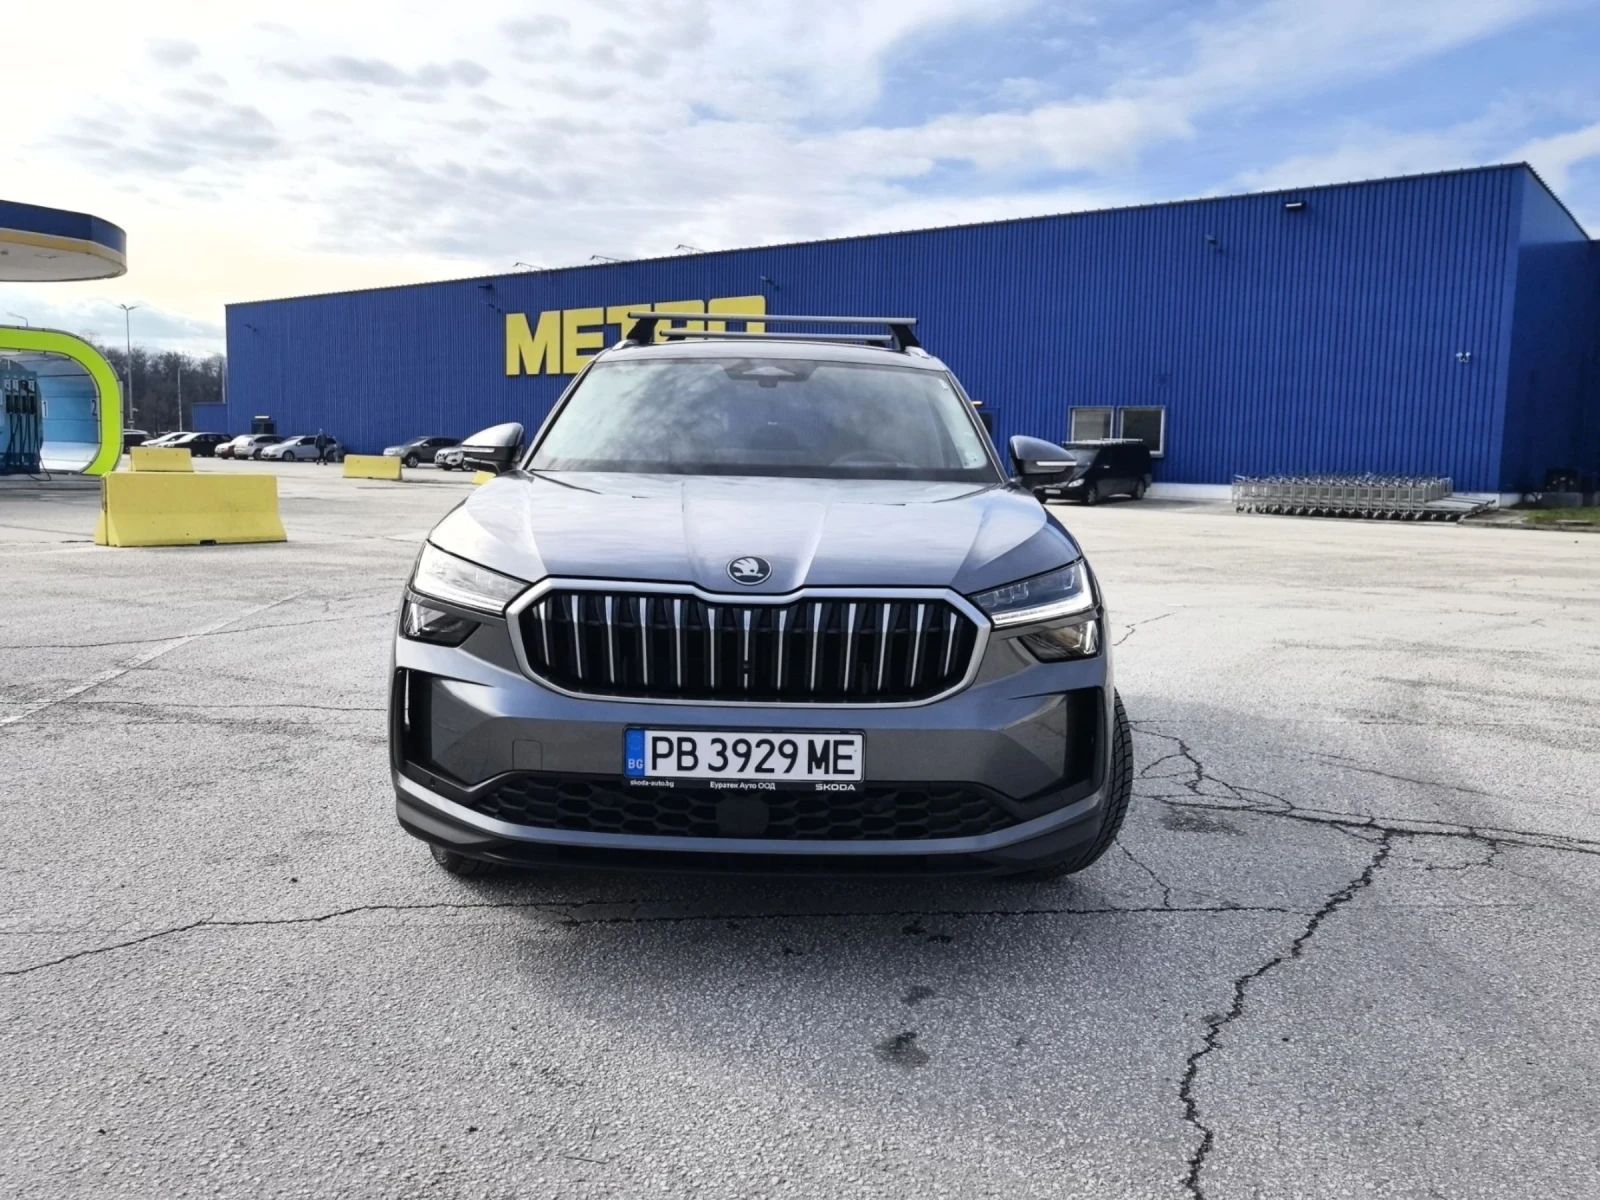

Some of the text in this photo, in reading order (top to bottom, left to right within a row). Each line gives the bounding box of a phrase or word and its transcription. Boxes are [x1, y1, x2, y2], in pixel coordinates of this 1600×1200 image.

[651, 736, 855, 775] PB 3929 ME
[628, 758, 644, 769] BG
[630, 780, 675, 788] skoda-auto.bg
[758, 782, 776, 790] ООД
